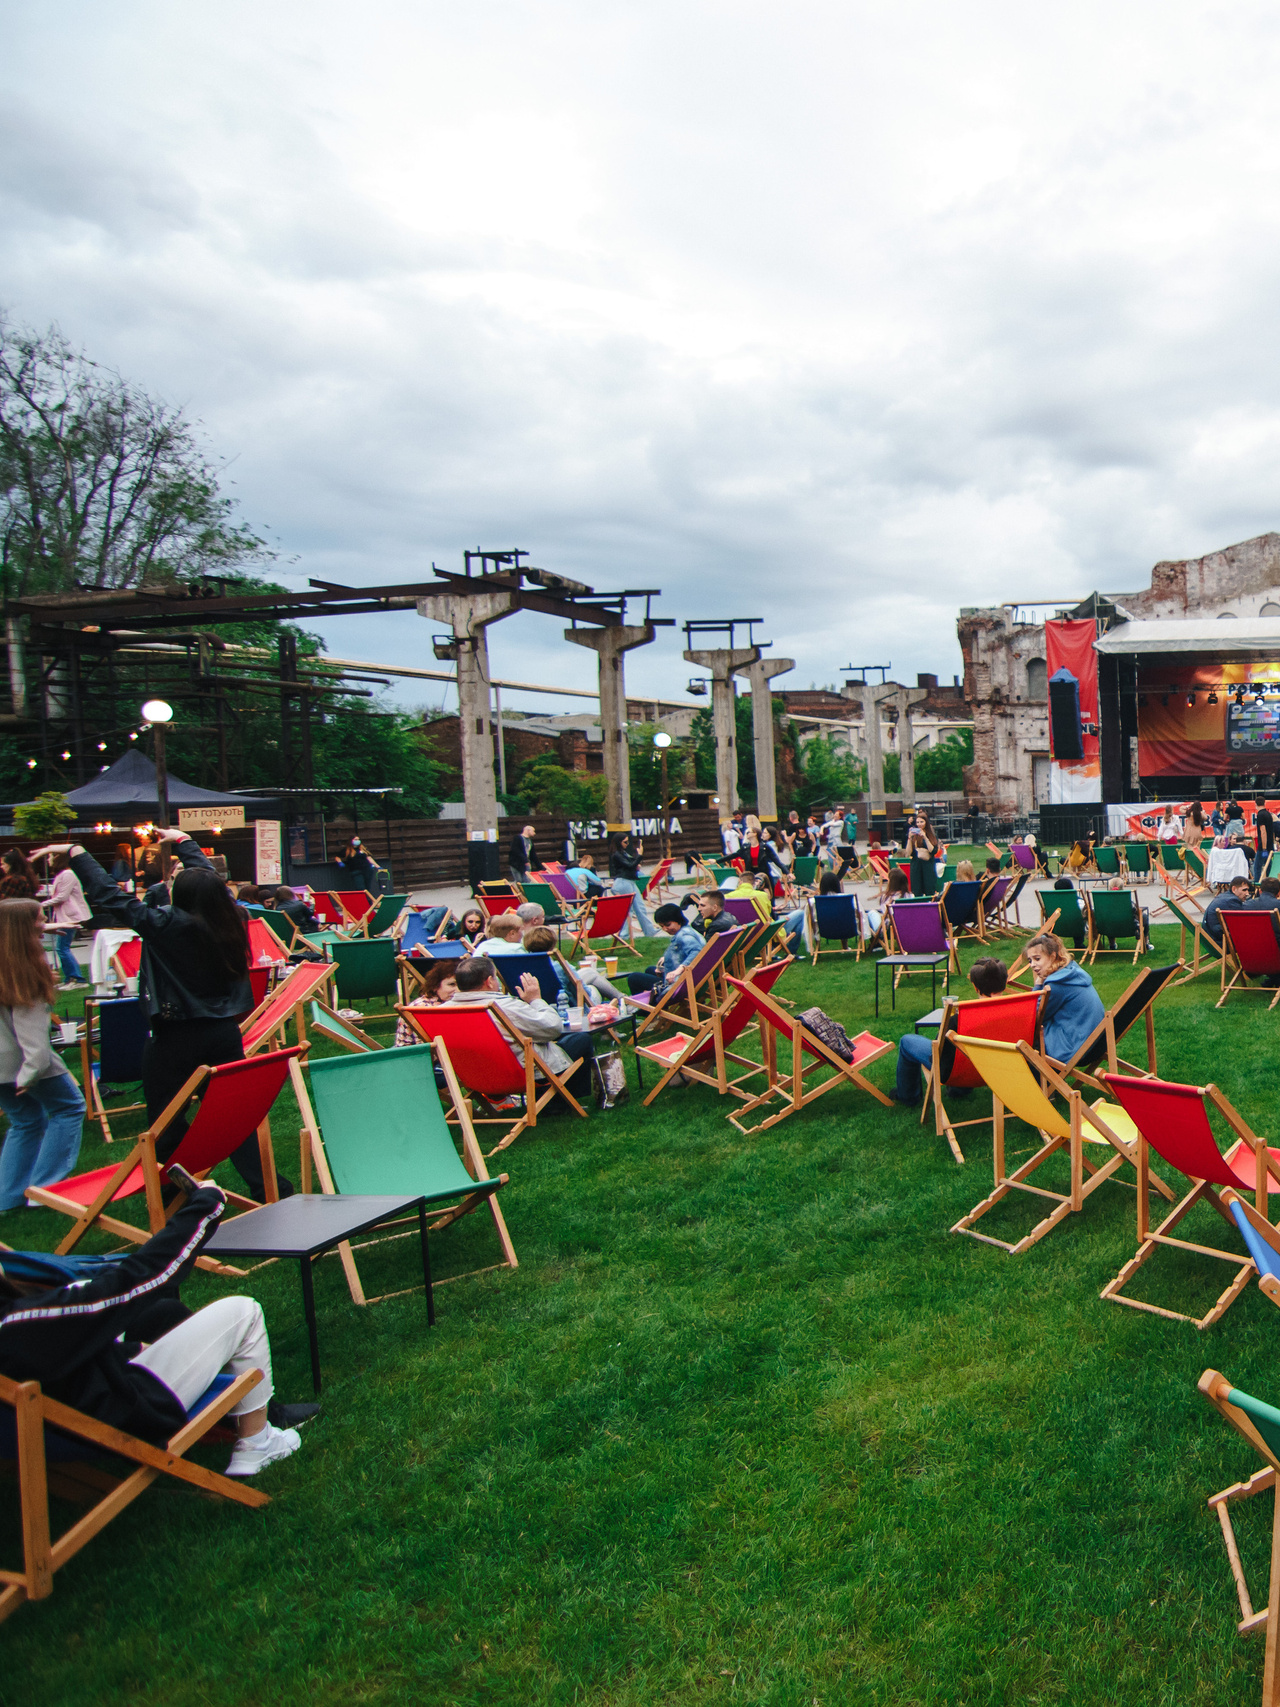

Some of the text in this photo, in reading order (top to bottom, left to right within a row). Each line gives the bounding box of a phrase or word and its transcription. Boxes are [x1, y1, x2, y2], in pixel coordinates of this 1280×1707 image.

[181, 808, 243, 818] ТУТ ГОТУЮТЬ
[569, 817, 683, 840] МЕХНИА
